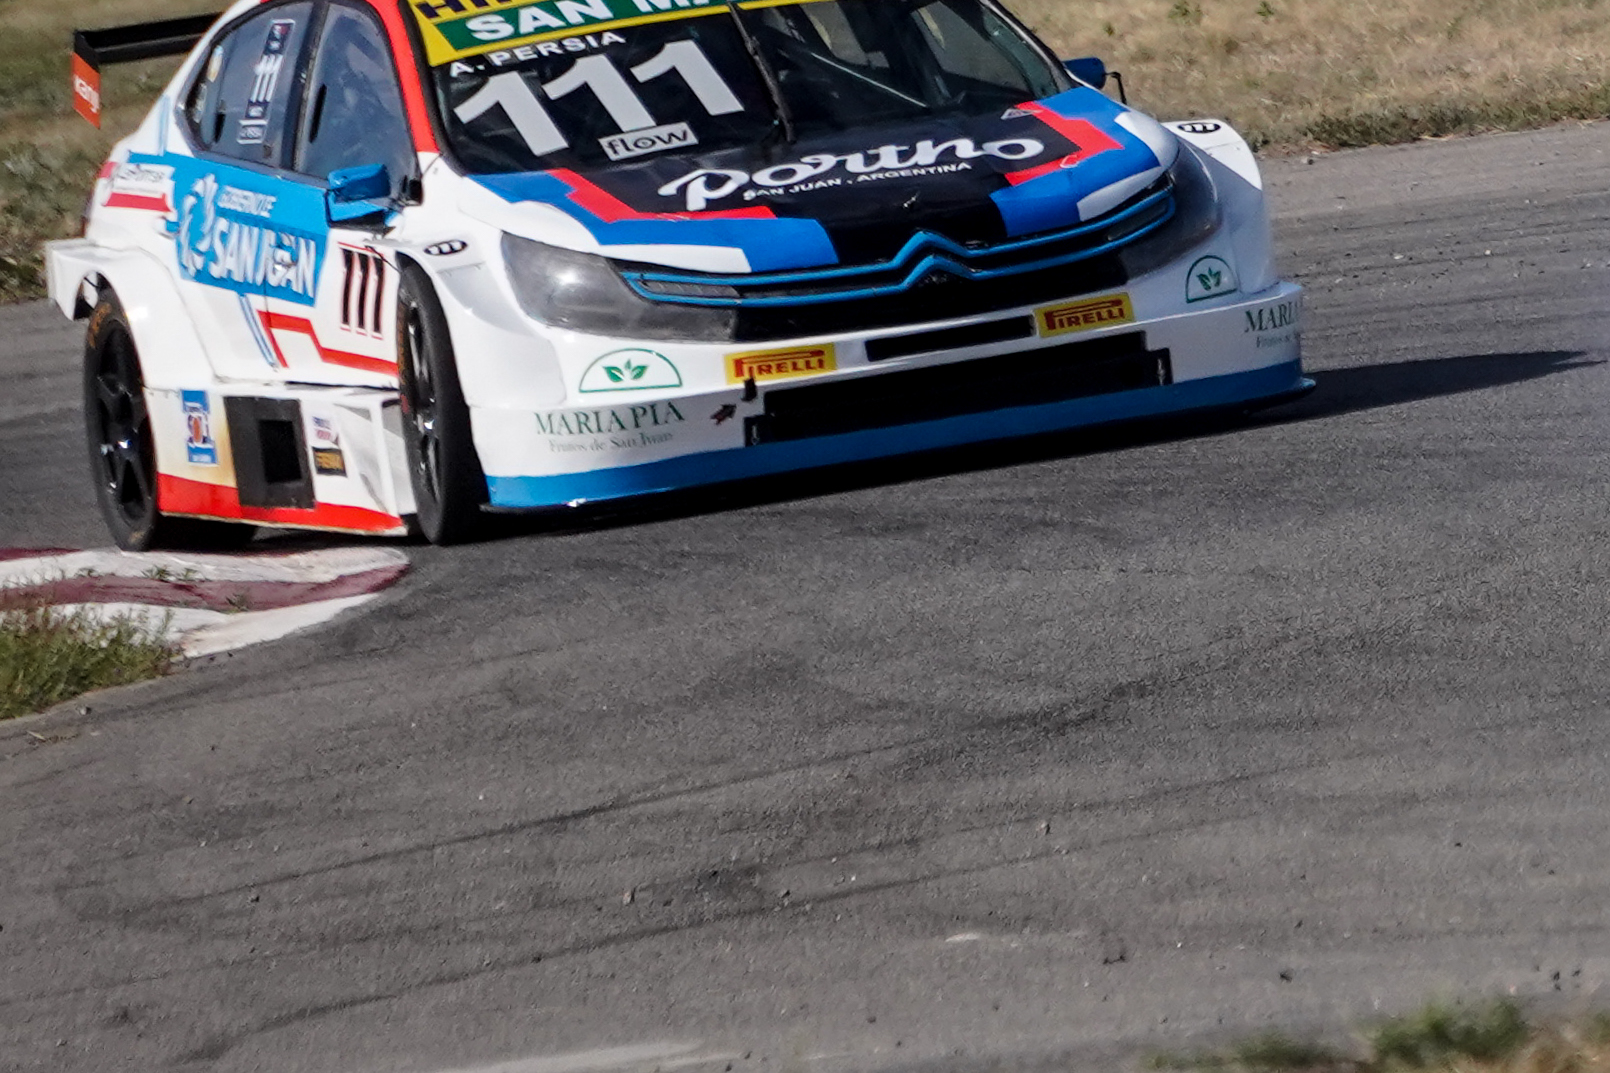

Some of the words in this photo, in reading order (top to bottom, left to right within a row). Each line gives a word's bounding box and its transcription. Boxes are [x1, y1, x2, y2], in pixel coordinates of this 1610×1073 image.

[495, 30, 626, 66] PERSIA
[453, 39, 746, 157] 111
[606, 125, 691, 157] flow
[743, 187, 785, 202] SAN
[789, 178, 841, 193] JUAN
[856, 162, 972, 182] ARGENTINA
[209, 217, 259, 285] SAN
[1044, 298, 1126, 331] PIRELLI
[733, 348, 826, 378] PIRELLI
[533, 410, 627, 436] MARIA
[628, 401, 686, 429] PIA
